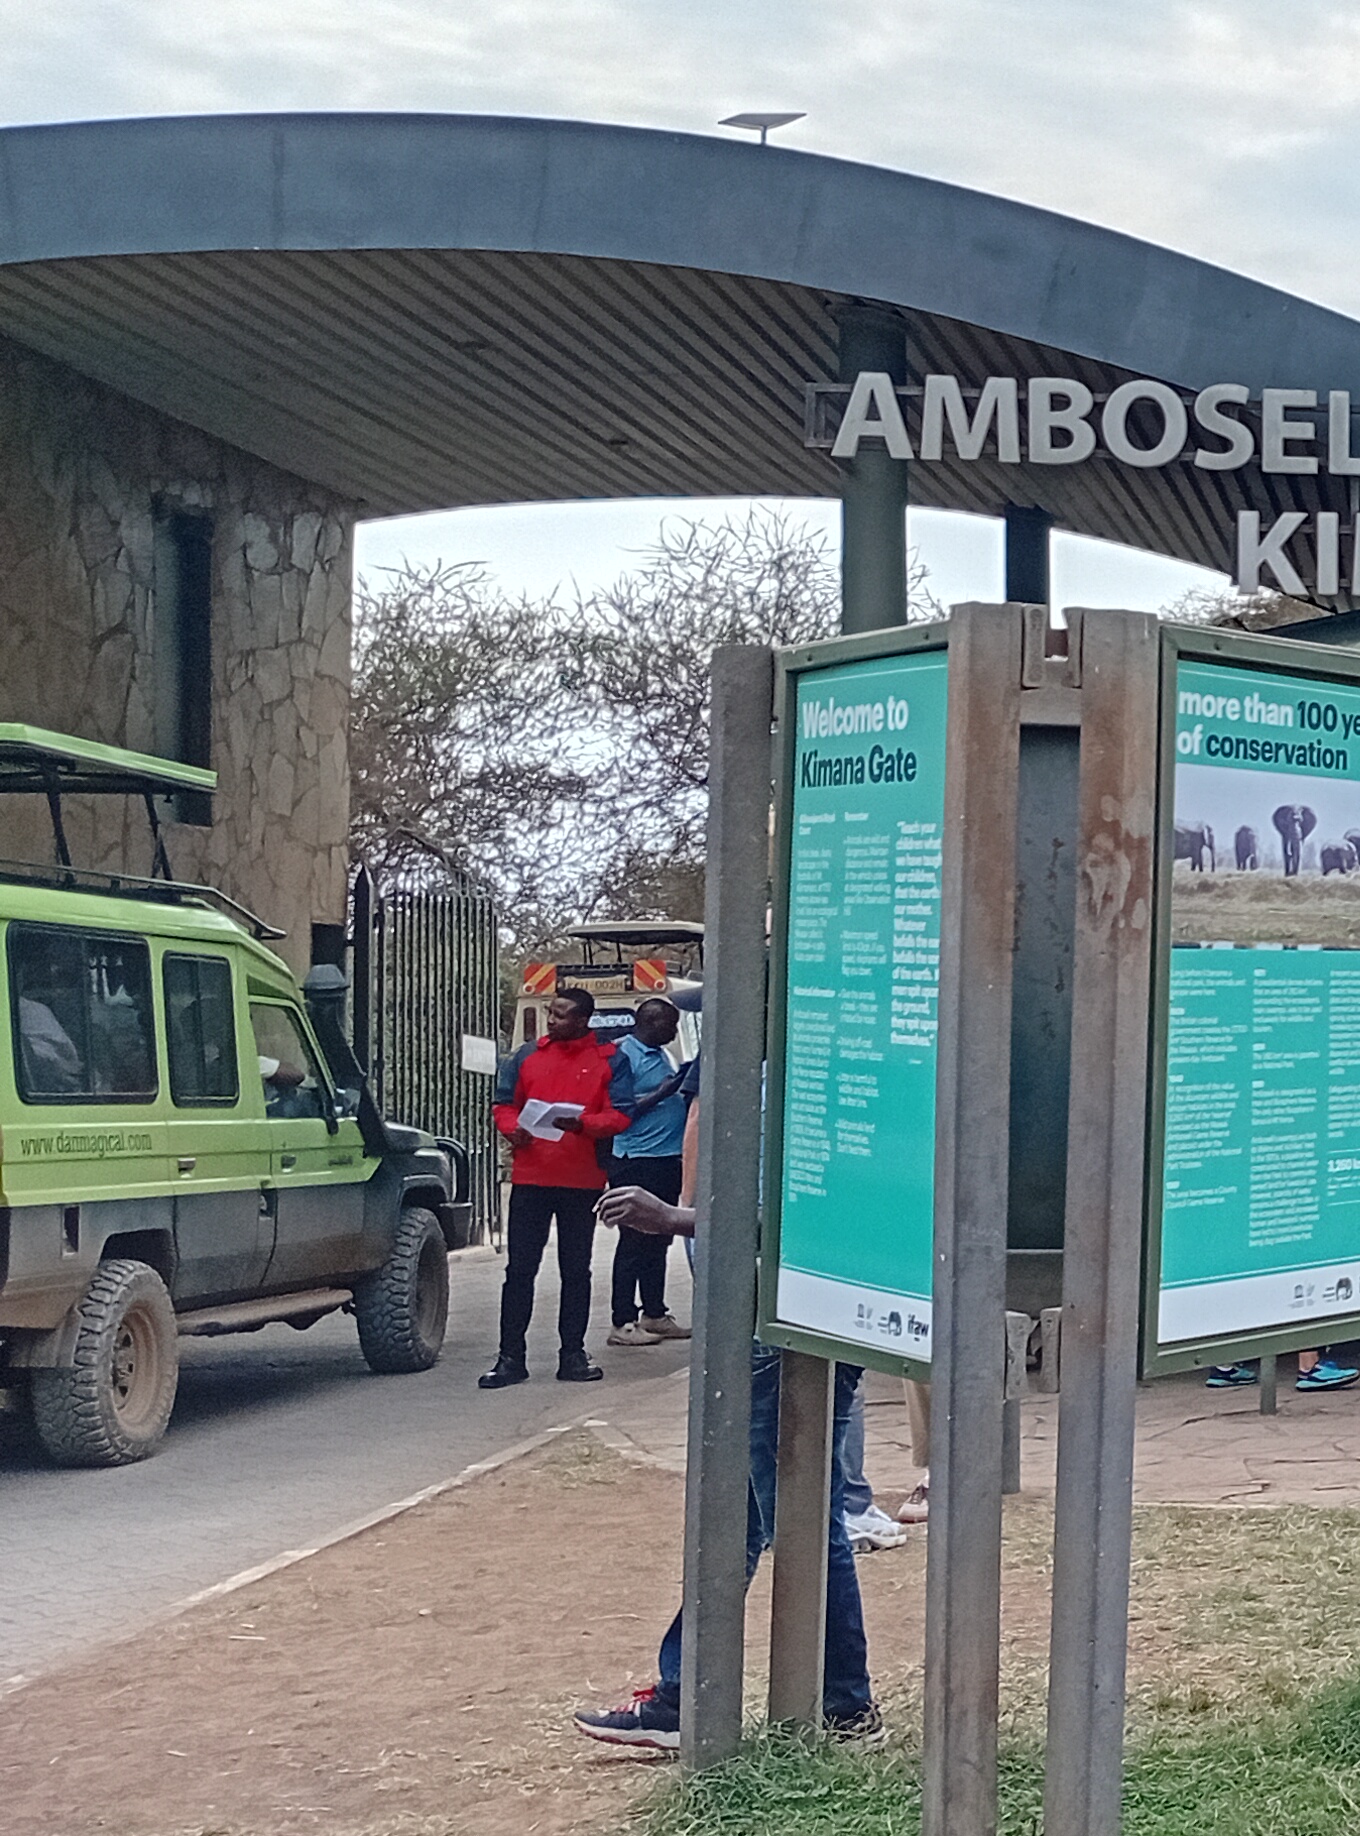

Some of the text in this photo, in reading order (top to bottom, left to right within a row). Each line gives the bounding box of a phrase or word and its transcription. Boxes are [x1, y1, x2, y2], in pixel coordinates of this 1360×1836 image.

[802, 695, 909, 739] Welcome to
[1178, 690, 1241, 721] more
[1243, 692, 1294, 728] than
[1297, 700, 1338, 732] 100
[801, 744, 917, 788] Kimana Gate
[1176, 724, 1348, 771] of conservation
